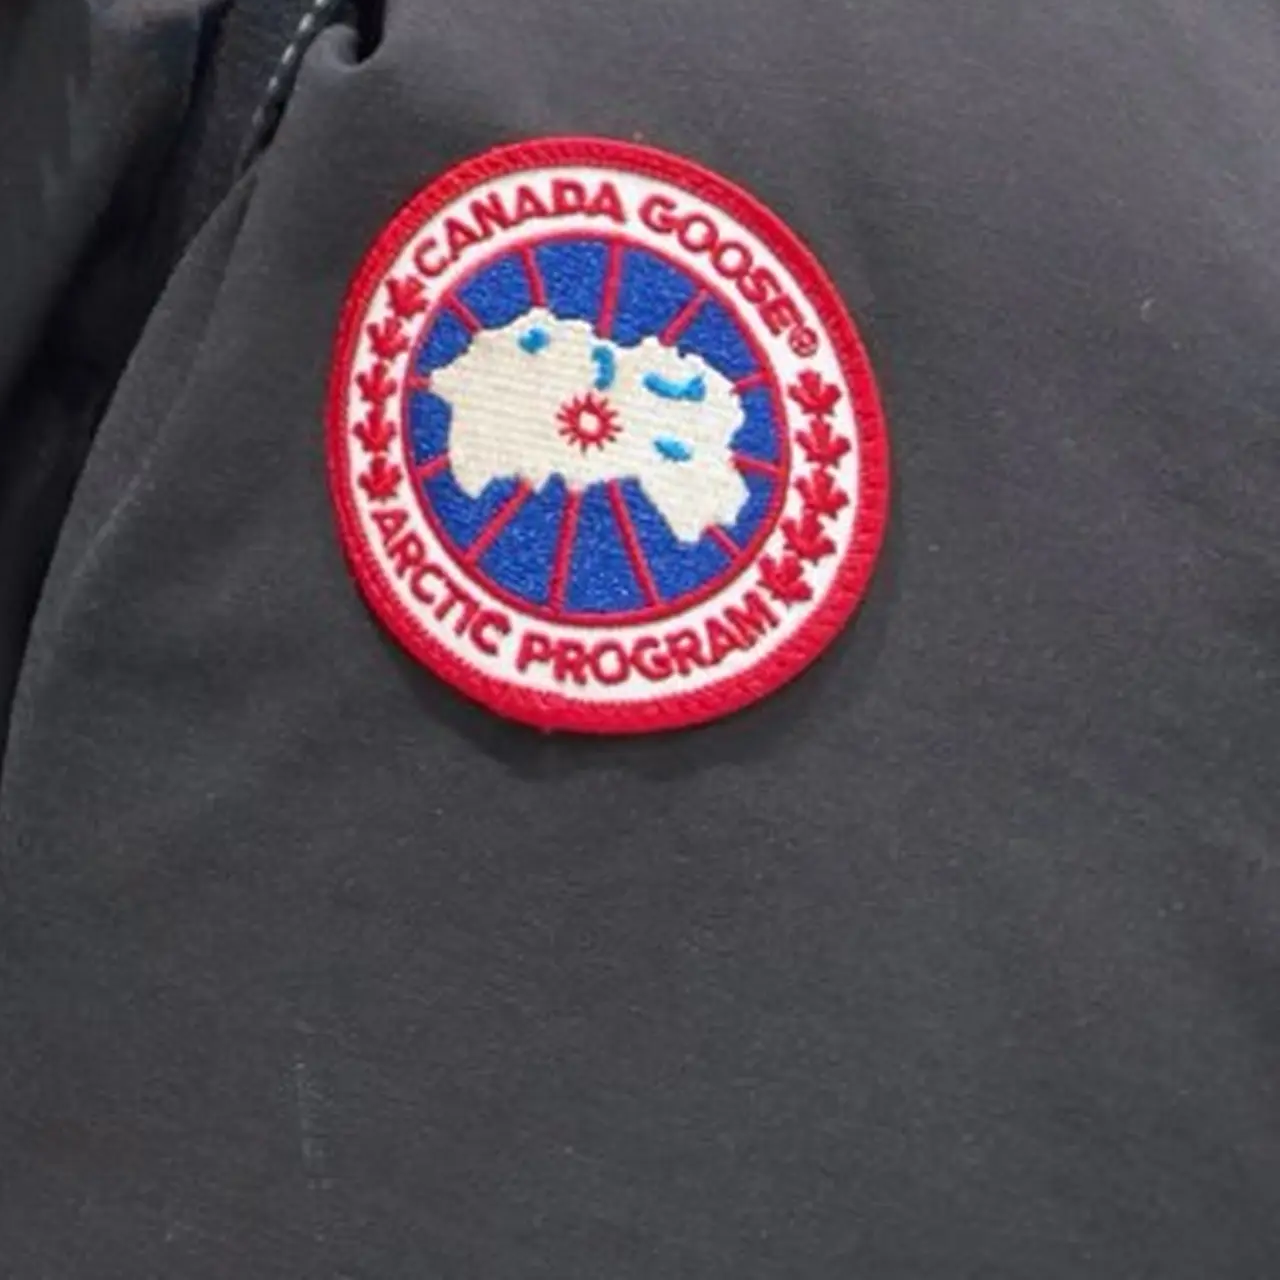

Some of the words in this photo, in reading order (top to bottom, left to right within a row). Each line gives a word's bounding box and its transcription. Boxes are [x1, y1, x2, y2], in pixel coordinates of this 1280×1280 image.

[413, 179, 627, 279] CANADA
[373, 506, 511, 657] ARCTIC
[516, 592, 781, 686] PROGRAM
